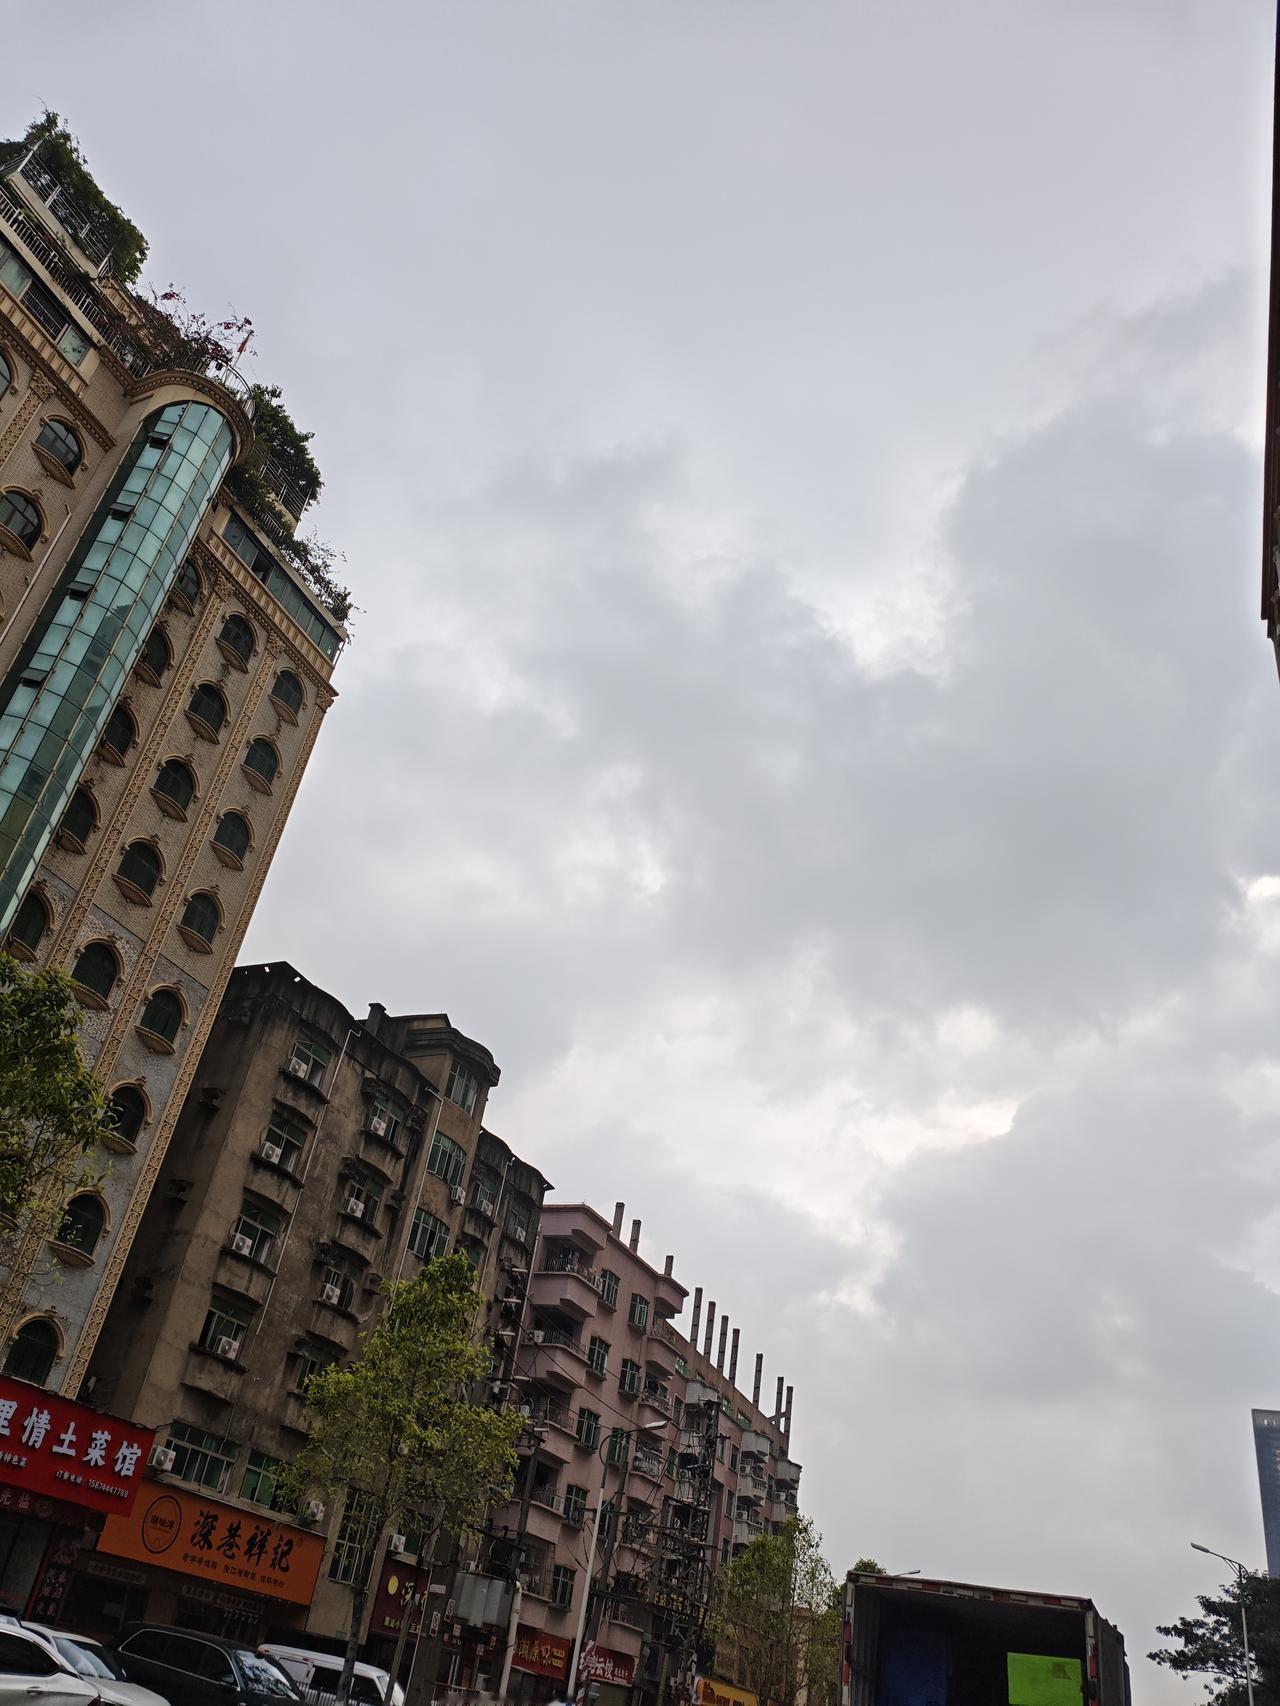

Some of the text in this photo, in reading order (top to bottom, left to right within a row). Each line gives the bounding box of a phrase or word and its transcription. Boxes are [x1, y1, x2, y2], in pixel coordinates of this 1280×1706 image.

[0, 1399, 142, 1477] 里情土菜馆
